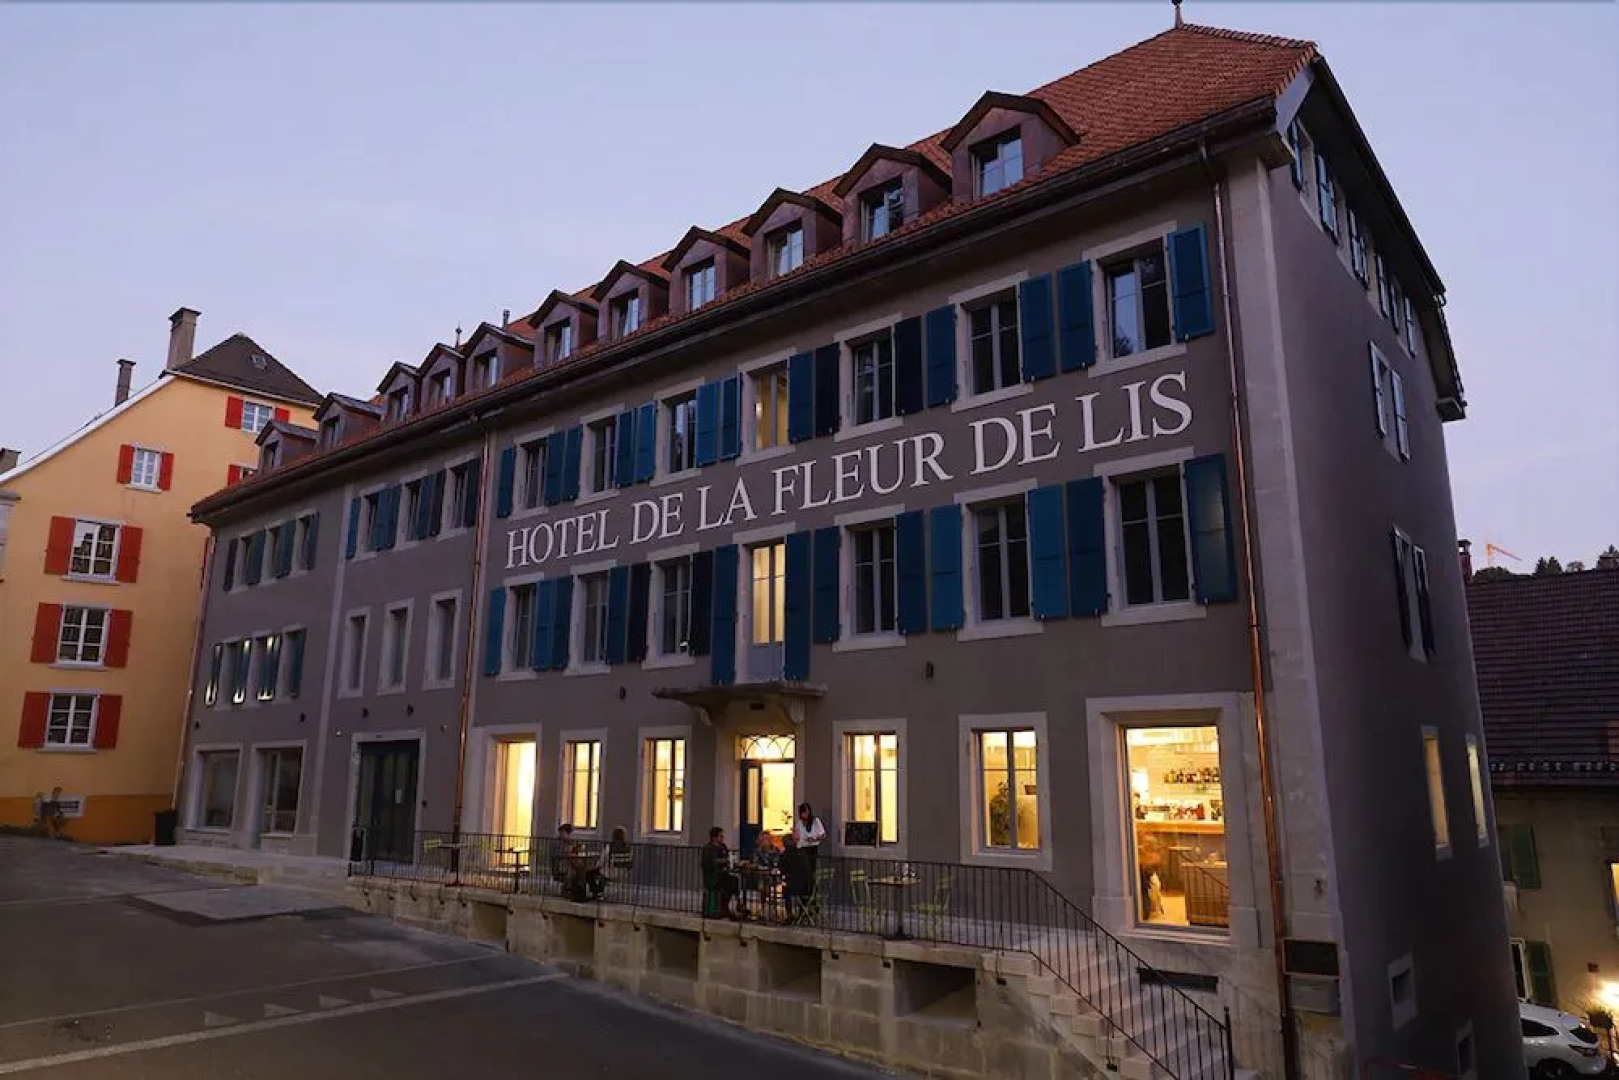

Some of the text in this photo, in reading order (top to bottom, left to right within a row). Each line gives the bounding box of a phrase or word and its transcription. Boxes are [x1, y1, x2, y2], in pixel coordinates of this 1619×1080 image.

[505, 371, 1192, 569] HOTEL DE LA FLEUR DE LIS
